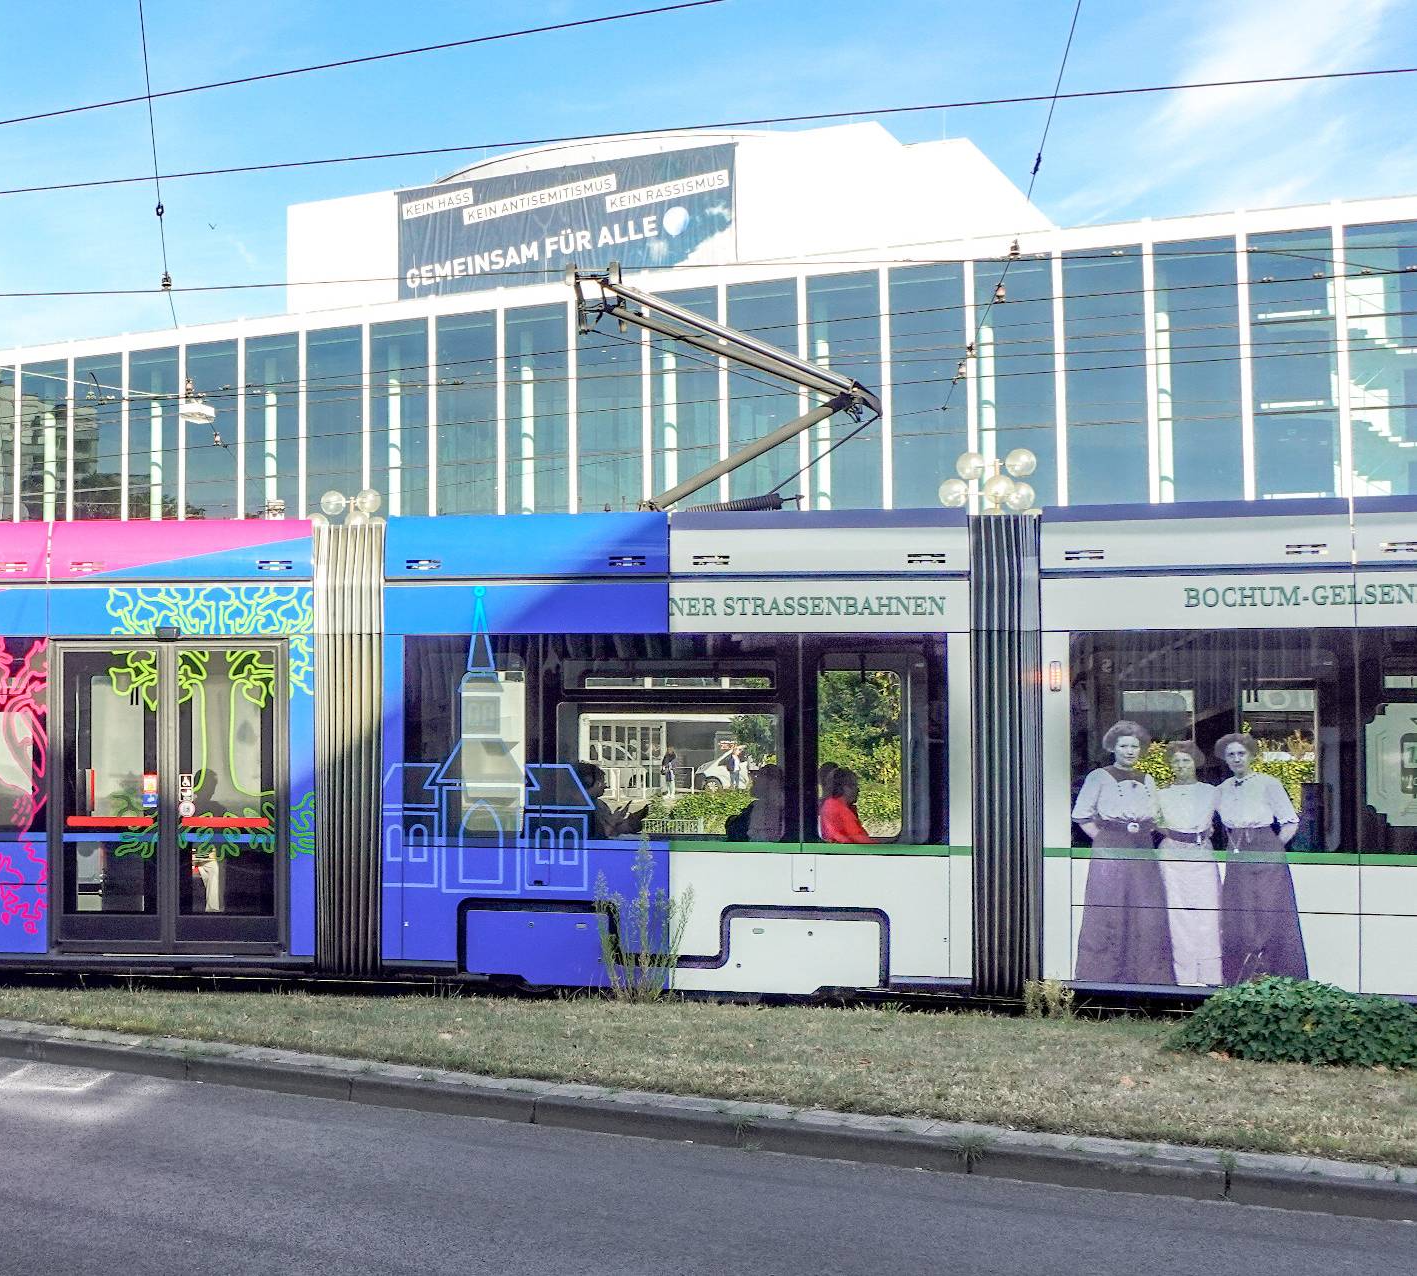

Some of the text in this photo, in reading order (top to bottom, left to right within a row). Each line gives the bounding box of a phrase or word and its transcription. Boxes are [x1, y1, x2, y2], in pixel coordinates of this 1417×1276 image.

[405, 192, 470, 216] KEIN HASS
[467, 178, 613, 222] KEIN ANTISEMITISMUS
[610, 174, 725, 209] KEIN RASSISMUS
[406, 215, 659, 289] GEMEINSAM FÜR ALLE
[723, 596, 946, 616] STRASSENBAHNEN
[1184, 583, 1417, 608] BOCHUM-GELSEN
